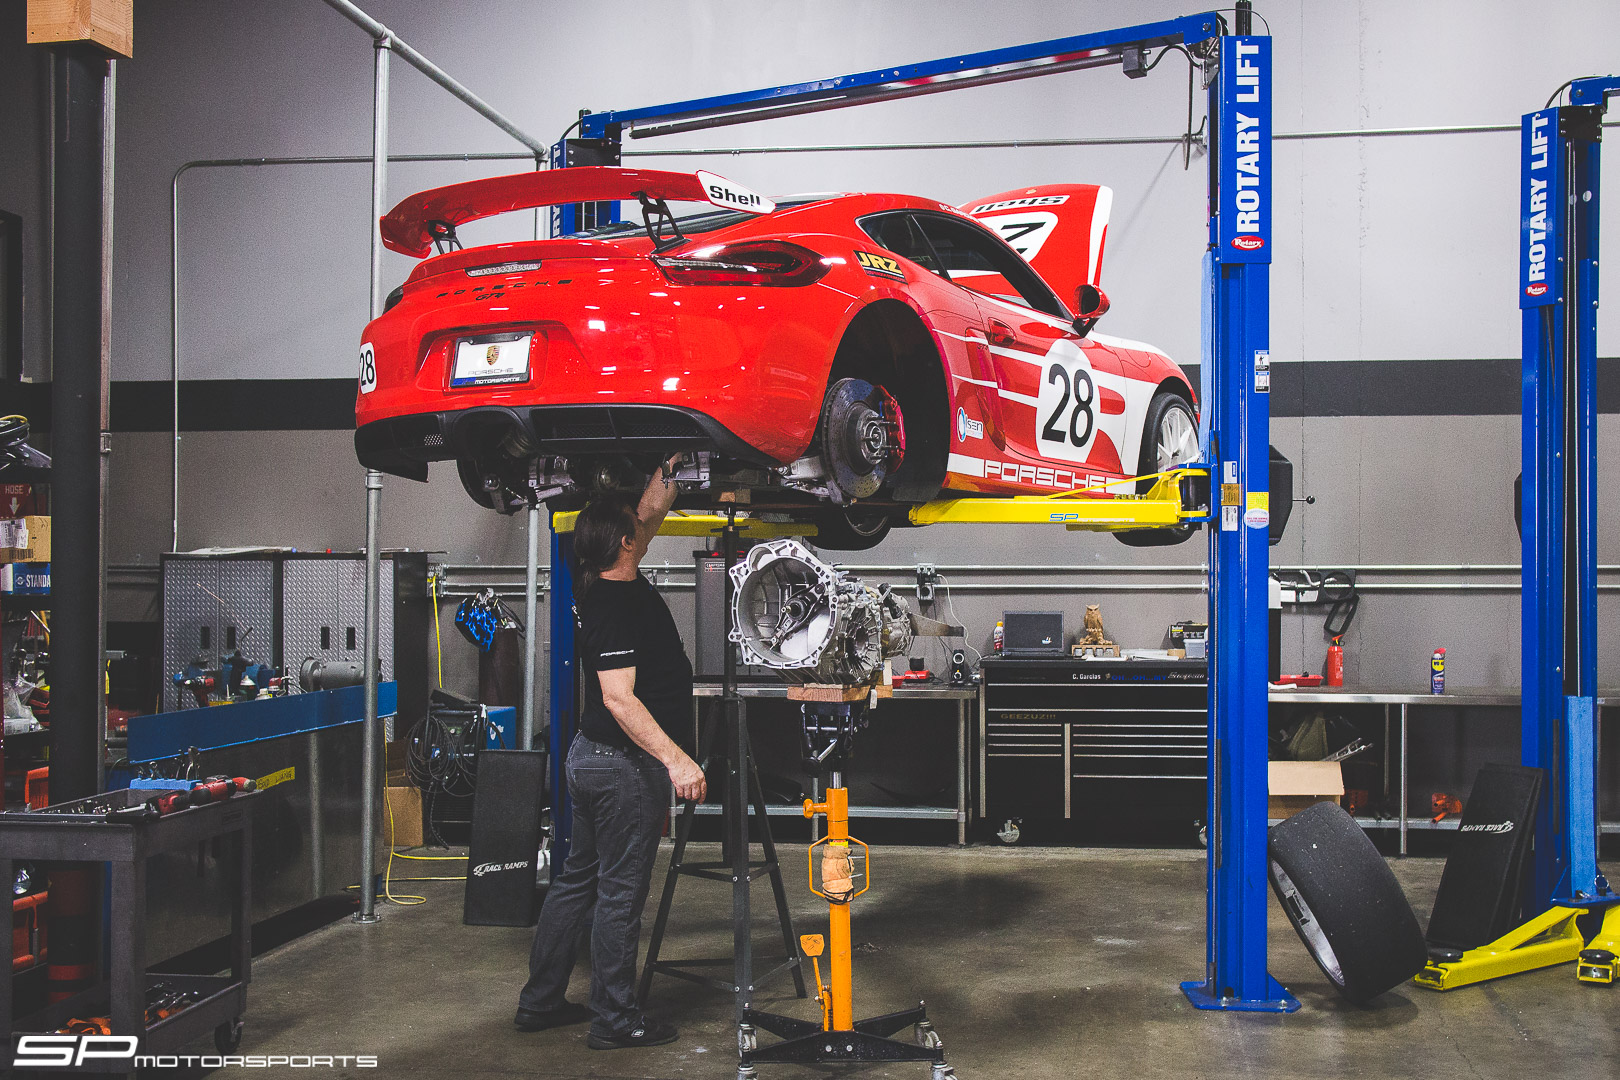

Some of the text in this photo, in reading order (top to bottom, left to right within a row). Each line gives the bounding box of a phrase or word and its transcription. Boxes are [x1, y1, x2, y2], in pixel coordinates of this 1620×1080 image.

[1236, 41, 1260, 233] ROTARY LIFT
[709, 185, 761, 206] Shell
[1529, 116, 1549, 282] ROTARY LIFT
[1233, 237, 1262, 248] Rotary
[858, 251, 903, 275] JRZ
[436, 279, 572, 299] PORSCHE
[360, 349, 375, 386] 28
[1041, 363, 1093, 447] 28
[985, 459, 1106, 493] PORSCHE
[5, 485, 24, 495] HOSE
[1049, 513, 1079, 522] SP
[26, 574, 51, 588] STANDA
